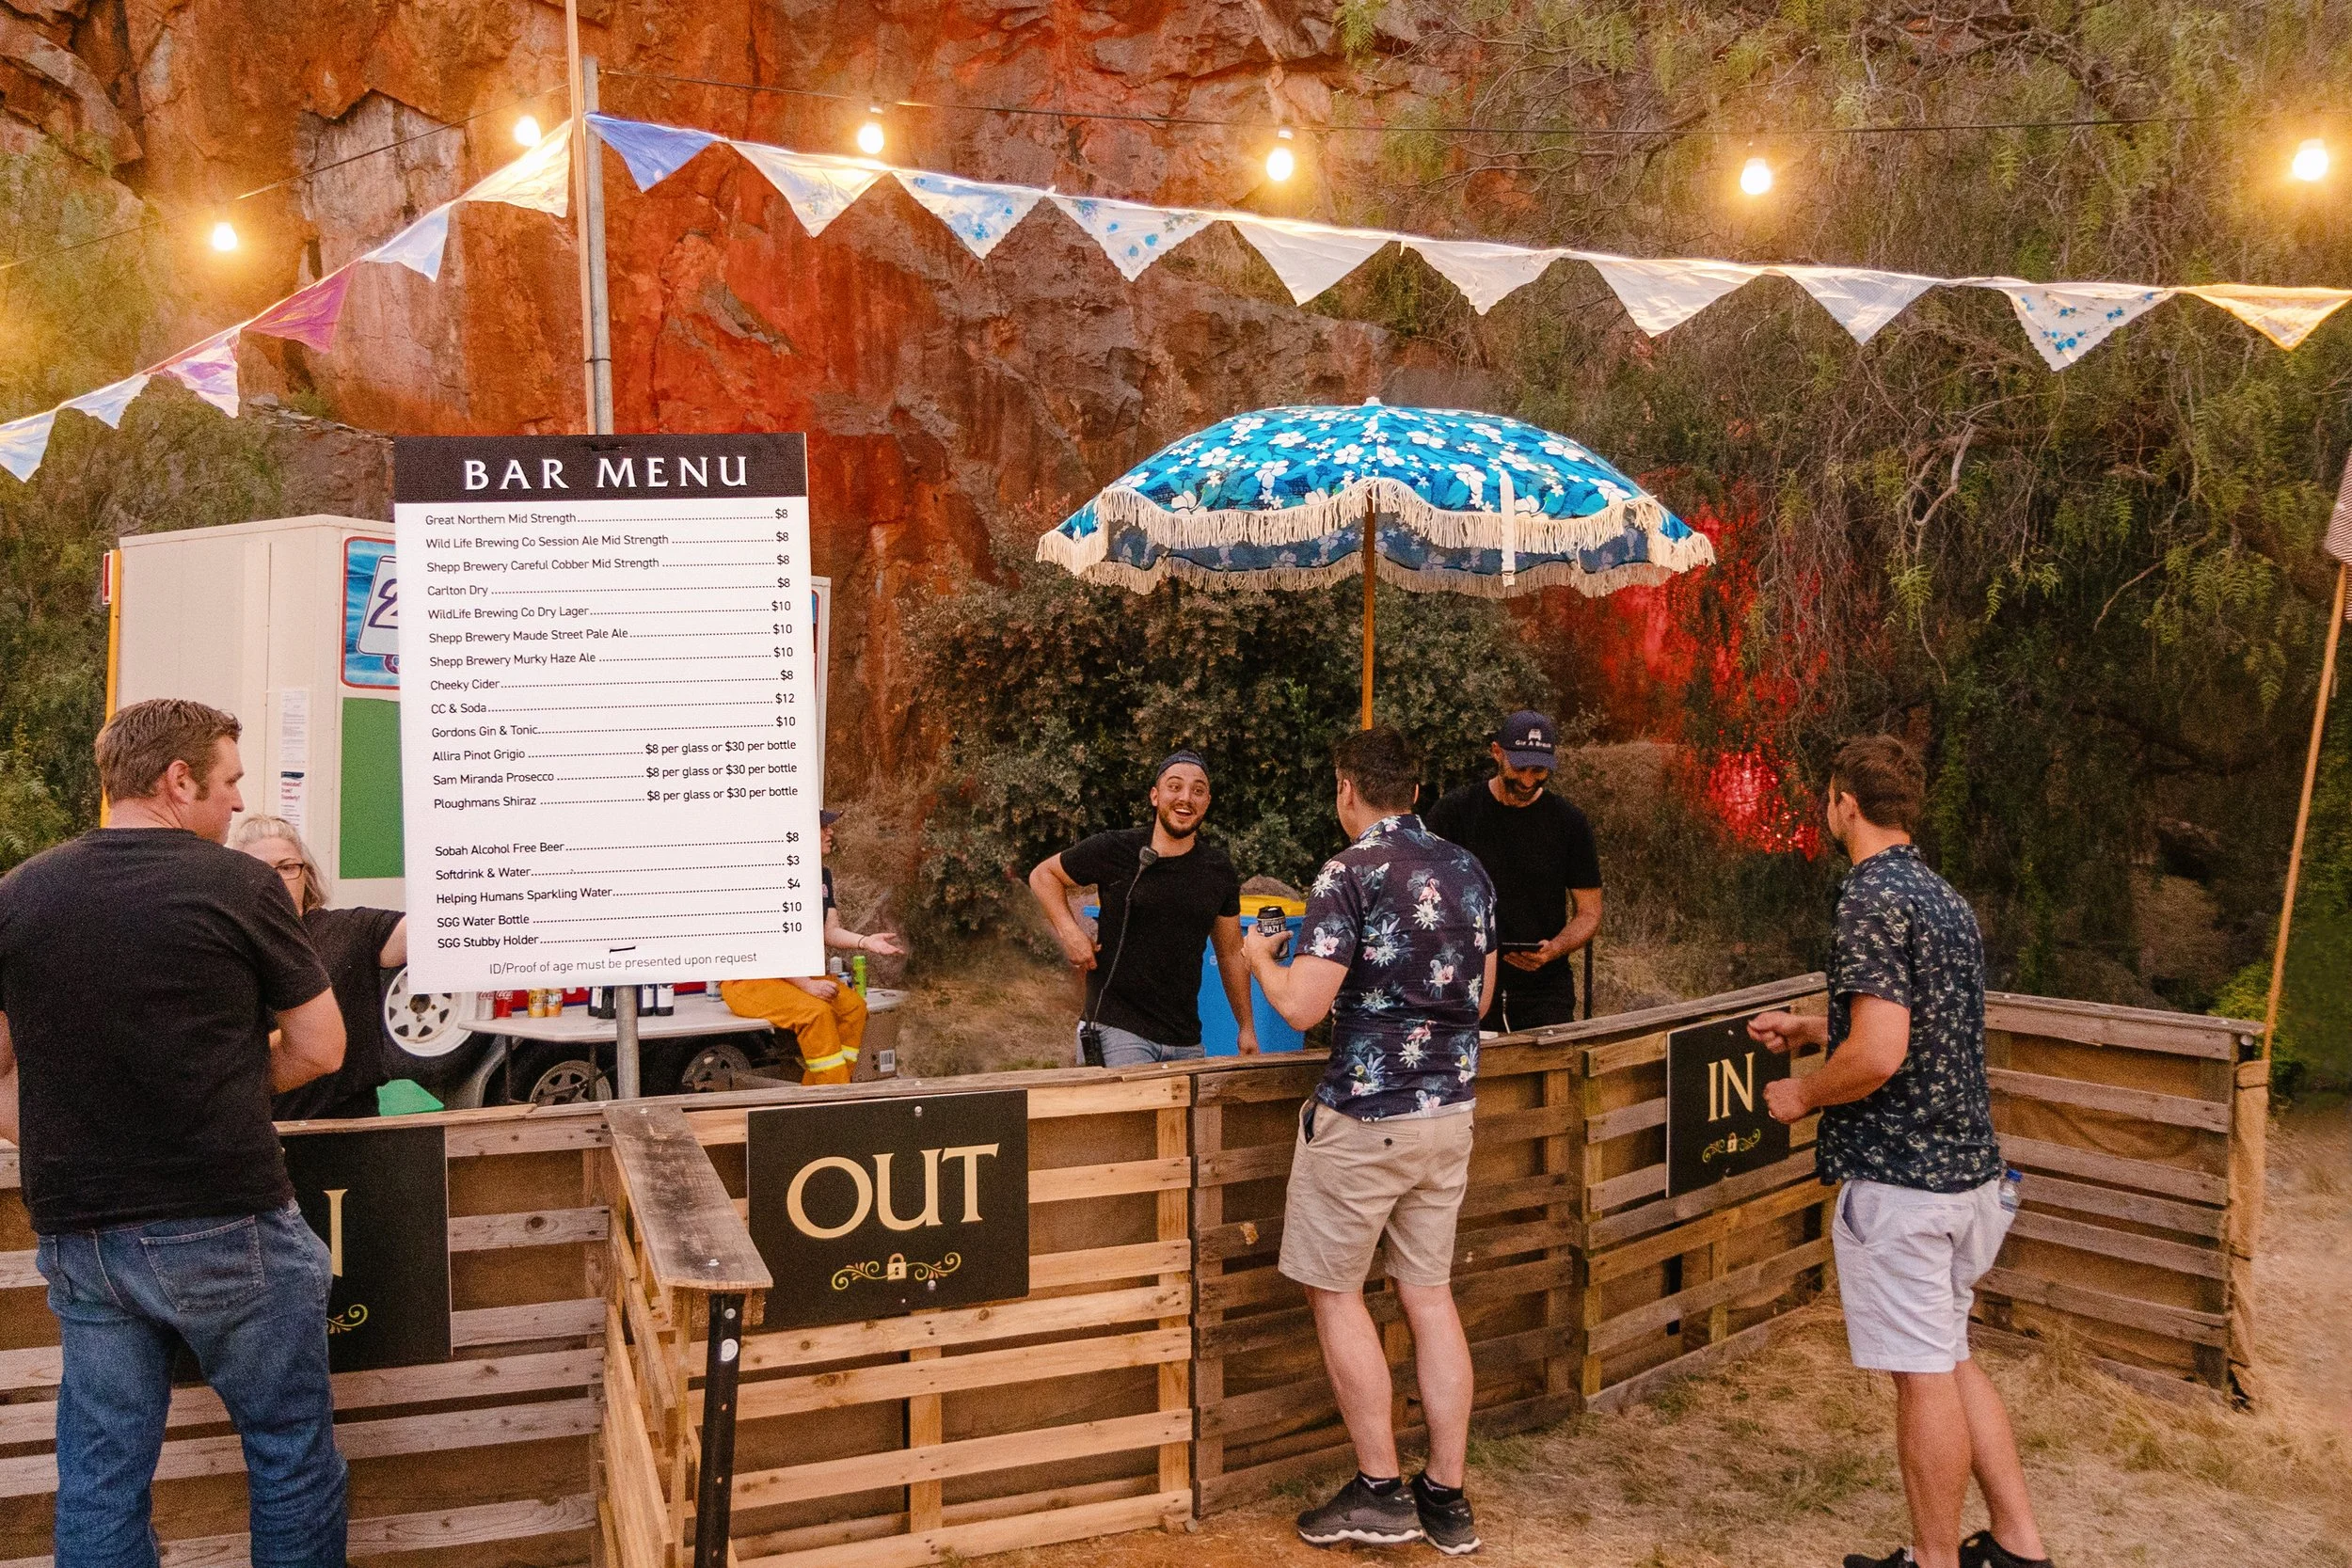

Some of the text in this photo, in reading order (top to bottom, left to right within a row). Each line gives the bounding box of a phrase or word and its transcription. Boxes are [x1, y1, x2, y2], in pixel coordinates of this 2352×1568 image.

[464, 456, 748, 490] BAR MENU
[425, 513, 577, 526] Great Northern Mid Strength
[774, 508, 788, 520] $8
[425, 534, 669, 549] Wild Life Brewing Co Session Ale Mid Strength
[775, 531, 789, 543] $8
[426, 558, 660, 574] Shepp Brewery Careful Cobber Mid Strength
[776, 554, 790, 565] $8
[777, 577, 791, 589] $8
[427, 585, 489, 597] Carlton Dry
[771, 600, 791, 612] $10
[427, 607, 590, 620] WildLife Brewing Co Dry Lager
[772, 624, 792, 635] $10
[428, 628, 628, 645] Shepp Brewery Maude Street Pale Ale
[773, 646, 793, 658] $10
[429, 653, 596, 669] Shepp Brewery Murky Haze Ale
[780, 669, 794, 681] $8
[430, 678, 501, 692] Cheeky Cider
[775, 692, 795, 705] $12
[431, 703, 487, 715] CC & Soda
[775, 715, 796, 728] $10
[431, 724, 540, 738] Gordons Gin & Tonic
[644, 739, 797, 756] $8 per glass or $30 per bottle
[432, 749, 526, 762] Allira Pinot Grigio
[645, 767, 660, 779] $8
[661, 768, 680, 779] per
[682, 767, 710, 779] glass
[725, 764, 746, 776] $30
[748, 766, 766, 776] per
[768, 763, 798, 774] bottle
[433, 772, 554, 785] Sam Miranda Prosecco
[646, 785, 799, 802] $8 per glass or $30 per bottle
[434, 796, 536, 811] Ploughmans Shiraz
[786, 832, 800, 844] $8
[435, 842, 565, 857] Sobah Alcohol Free Beer
[787, 854, 800, 866] $3
[436, 867, 532, 880] Softdrink & Water
[787, 878, 801, 890] $4
[436, 887, 613, 906] Helping Humans Sparkling Water
[782, 901, 803, 913] $10
[437, 914, 530, 928] SGG Water Bottle
[782, 922, 803, 934] $10
[437, 934, 539, 949] SGG Stubby Holder
[489, 953, 757, 975] ID/Proof of age must be presented upon request
[1708, 1052, 1756, 1122] IN
[787, 1143, 1000, 1240] OUT
